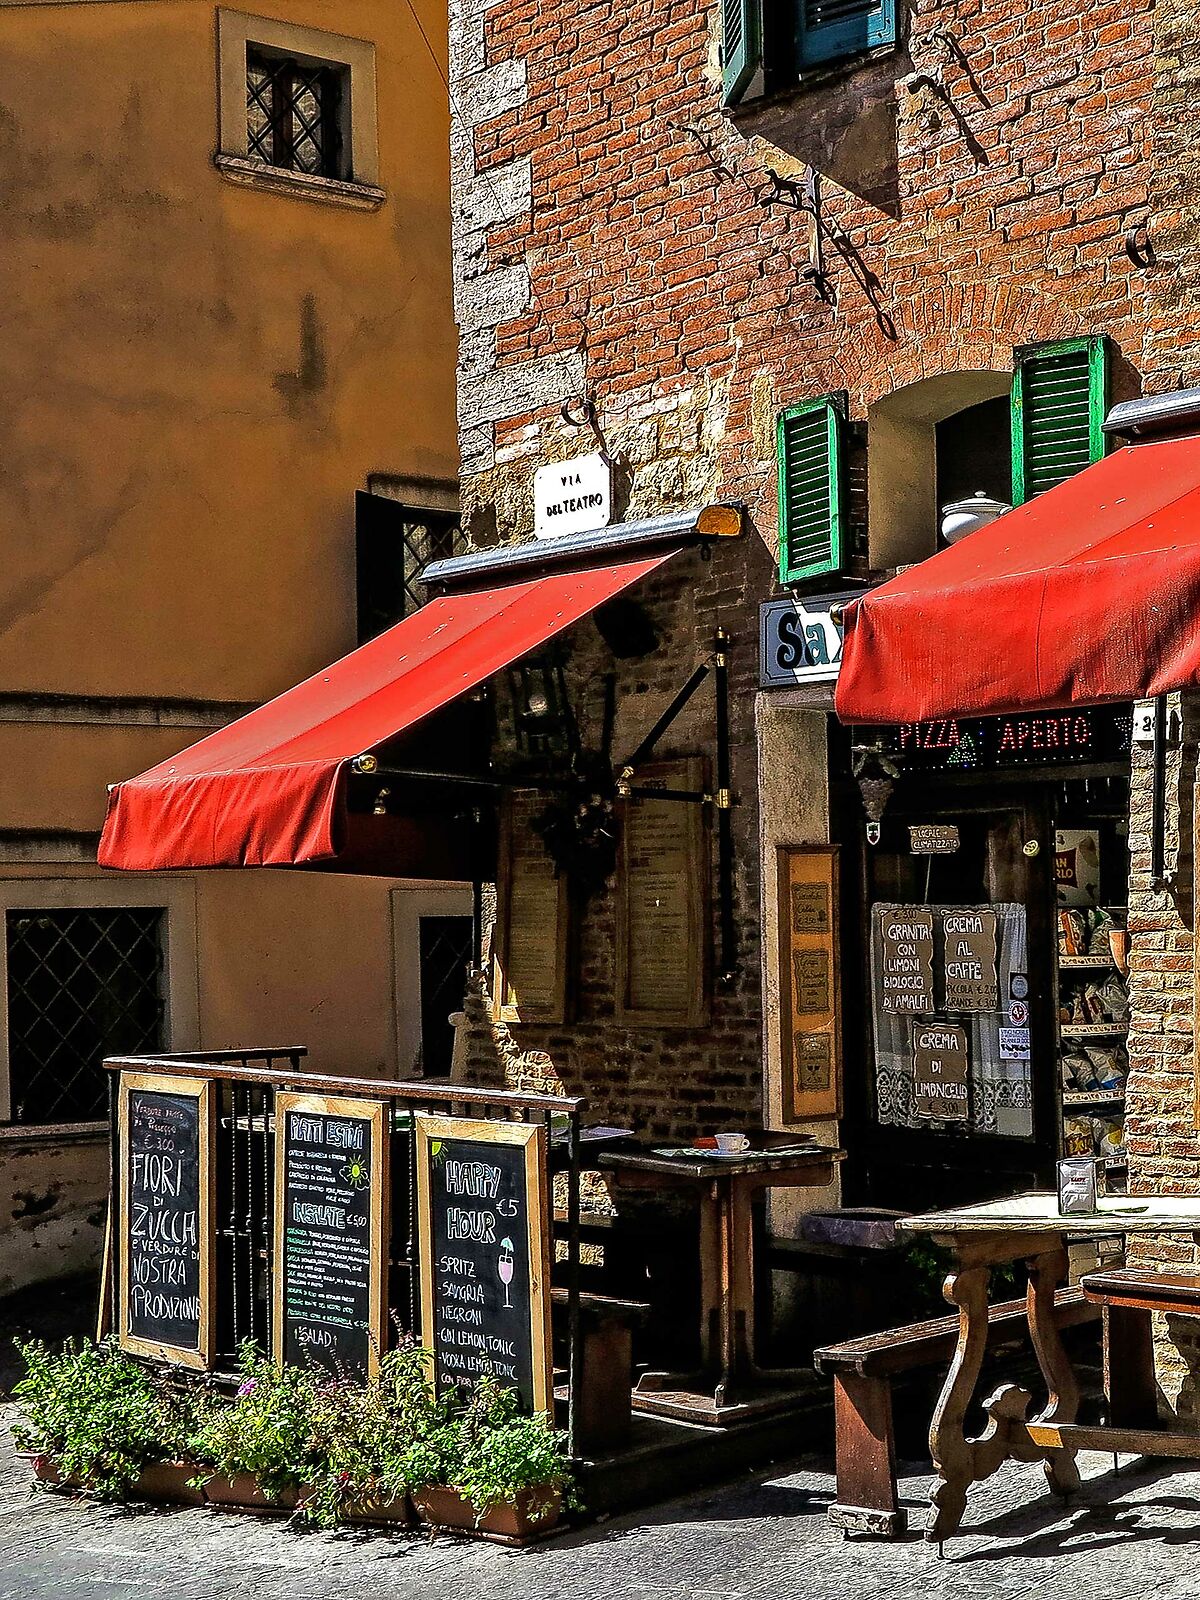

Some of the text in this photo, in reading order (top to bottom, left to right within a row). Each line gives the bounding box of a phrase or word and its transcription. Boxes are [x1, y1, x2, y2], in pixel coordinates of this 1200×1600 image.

[561, 473, 582, 487] VIA
[546, 493, 603, 517] DEL TEATRO
[900, 718, 960, 749] PIZZA
[1000, 716, 1089, 750] APERTO
[887, 923, 930, 941] GRANITA
[945, 916, 983, 934] CREMA
[896, 943, 917, 956] CON
[957, 941, 973, 956] AL
[887, 956, 920, 972] LIMONI
[895, 994, 929, 1010] AMALFI
[919, 1031, 959, 1051] CREMA
[931, 1058, 942, 1074] DI
[914, 1082, 968, 1100] LIMONCELLO
[131, 1149, 185, 1197] FIORI
[445, 1160, 502, 1199] HAPPY
[152, 1195, 164, 1207] DI
[495, 1198, 520, 1217] €5
[292, 1196, 346, 1230] INSALATE
[131, 1201, 197, 1246] ZUCCA
[446, 1206, 496, 1244] HOUR
[132, 1253, 187, 1286] NOSTRA
